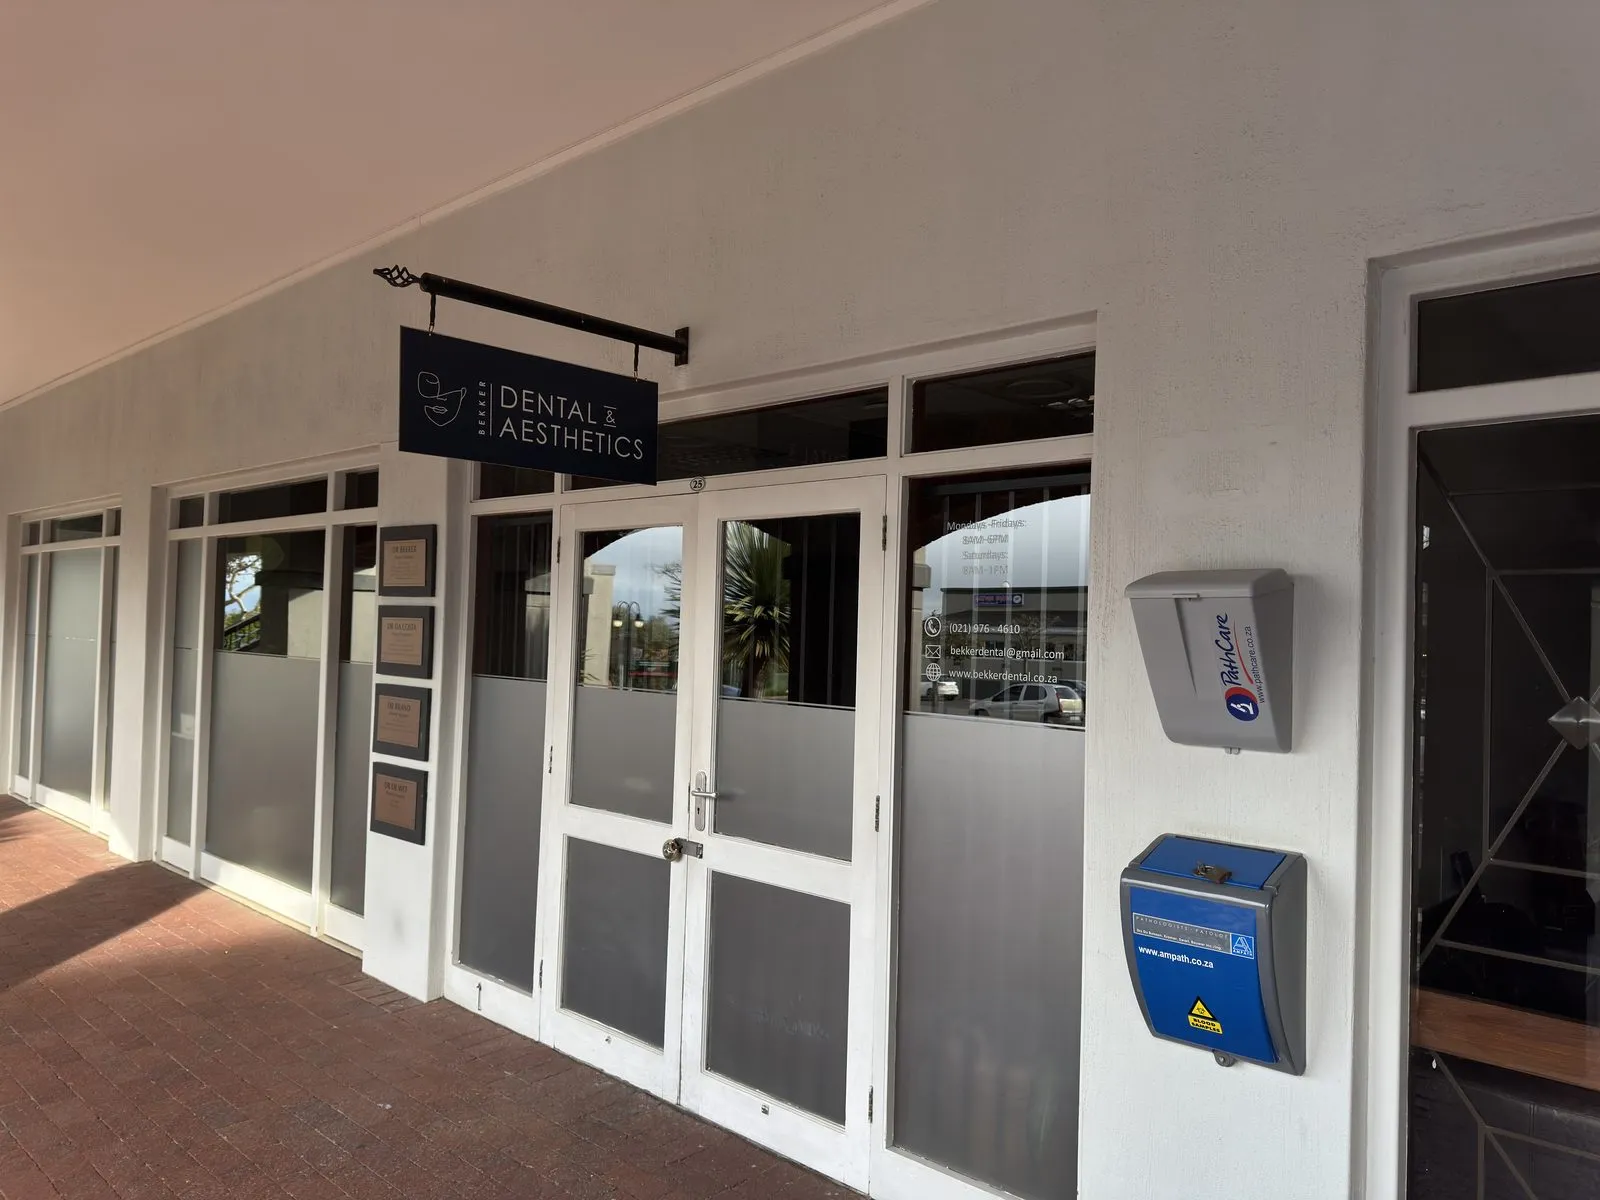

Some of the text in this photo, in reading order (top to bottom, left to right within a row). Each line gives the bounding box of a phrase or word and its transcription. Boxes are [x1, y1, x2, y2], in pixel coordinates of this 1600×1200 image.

[478, 380, 487, 435] BEKKER
[501, 385, 616, 425] DENTAL &
[499, 416, 644, 460] AESTHETICS
[693, 480, 703, 489] 25
[949, 623, 971, 635] (021)
[973, 624, 990, 634] 976
[997, 624, 1021, 634] 4610
[950, 645, 1065, 660] bekkerdental@gmail.com
[1215, 612, 1242, 686] PathCare
[948, 669, 1058, 684] www.bekkerdental.co.za
[1244, 626, 1265, 704] www.pathcare.co.za
[1138, 946, 1214, 969] www.ampath.co.za
[1192, 1017, 1216, 1027] BLOOD
